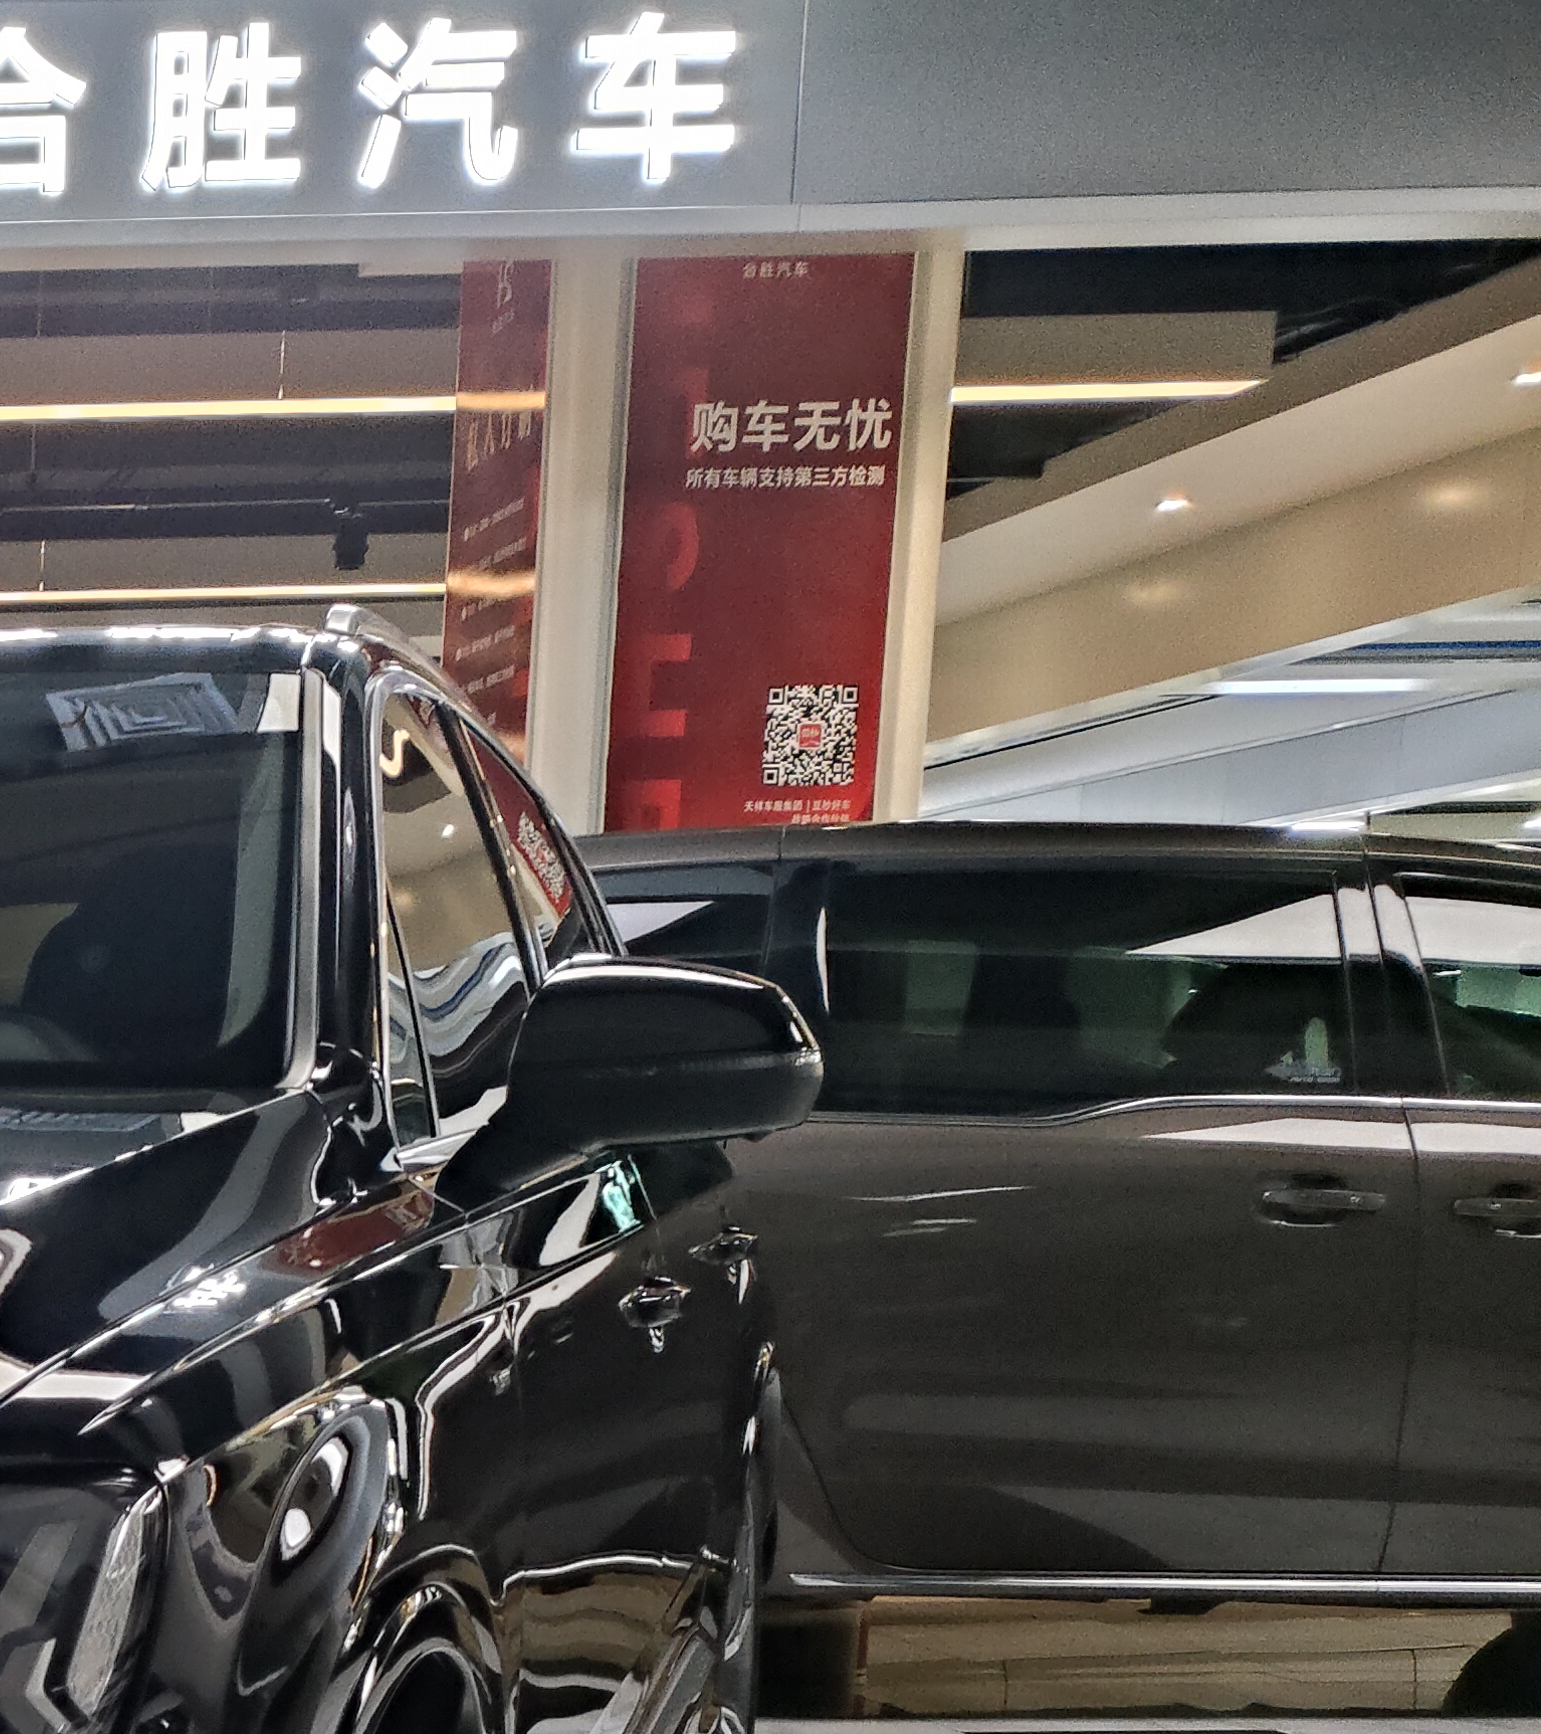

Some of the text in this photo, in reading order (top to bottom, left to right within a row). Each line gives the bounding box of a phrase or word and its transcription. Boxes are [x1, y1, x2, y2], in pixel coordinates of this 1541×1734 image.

[690, 398, 893, 452] 购车无忧
[685, 464, 886, 489] 所有车辆支持第三方检测
